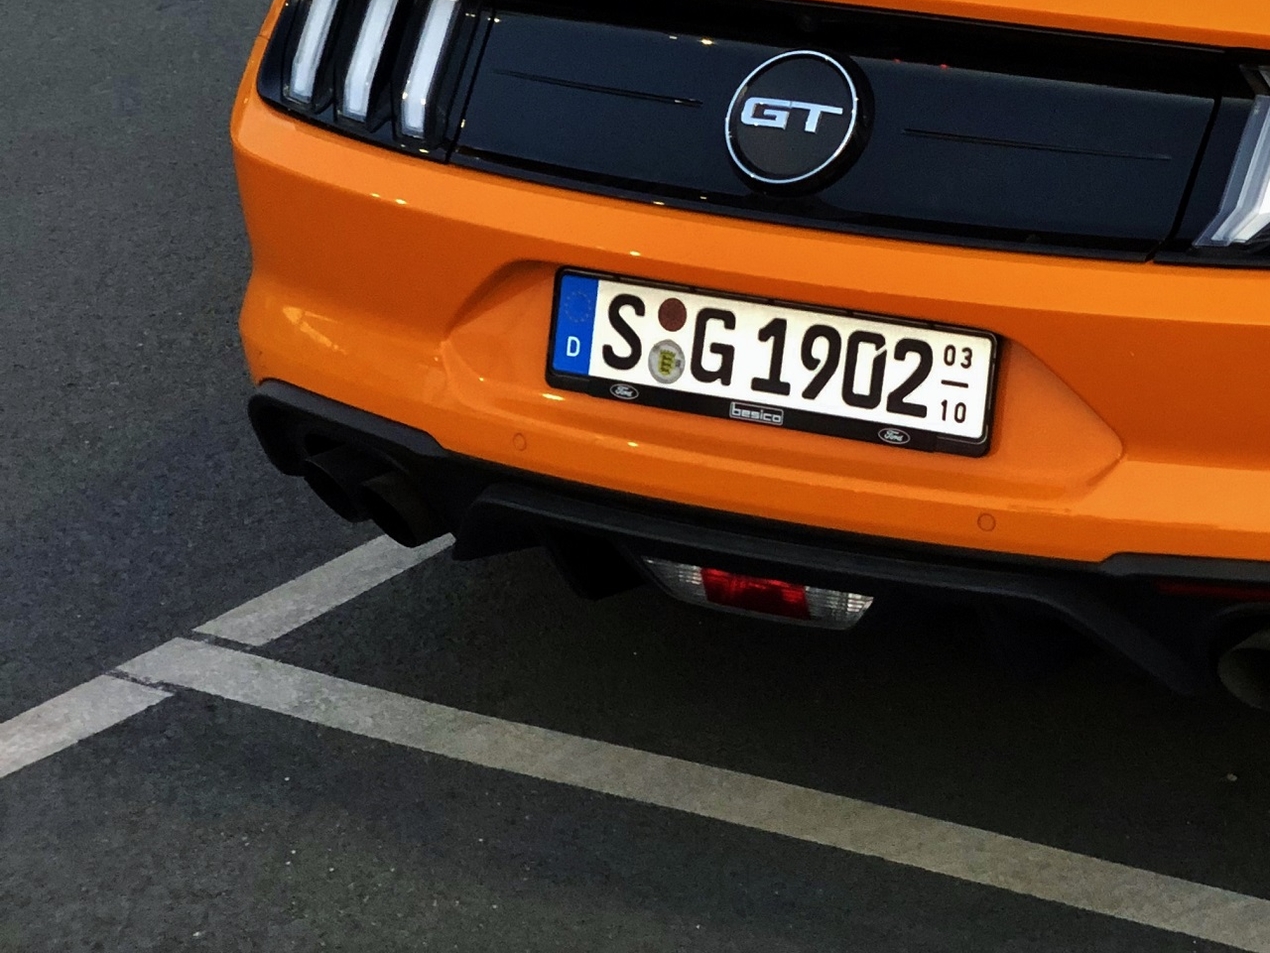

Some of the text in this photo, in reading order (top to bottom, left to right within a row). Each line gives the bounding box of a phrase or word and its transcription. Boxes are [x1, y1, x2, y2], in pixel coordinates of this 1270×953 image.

[741, 96, 844, 135] GT
[602, 293, 646, 371] S
[566, 335, 580, 357] D
[943, 344, 973, 369] 03
[940, 398, 967, 424] 10
